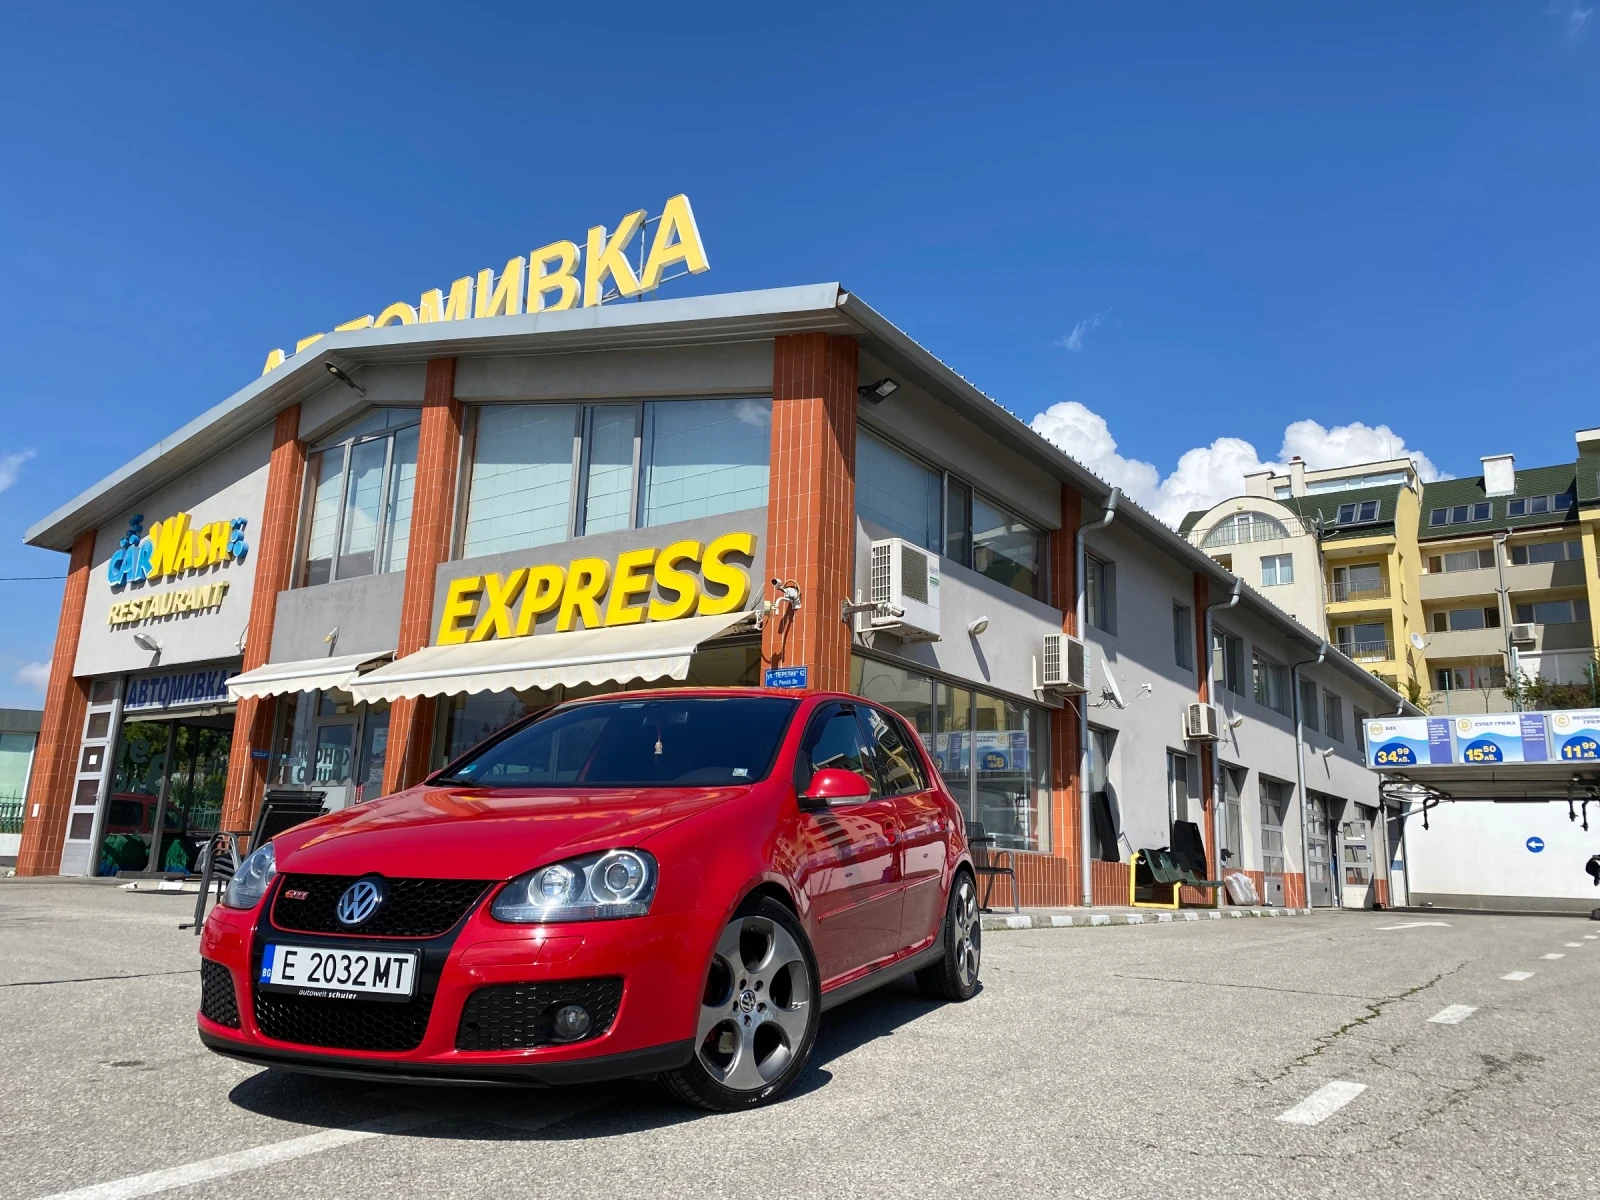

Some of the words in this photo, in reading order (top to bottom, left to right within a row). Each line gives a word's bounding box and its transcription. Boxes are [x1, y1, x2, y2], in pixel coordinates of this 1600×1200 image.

[262, 193, 710, 375] МИВКА
[436, 532, 757, 645] EXPRESS
[107, 581, 229, 624] RESTAURANT
[126, 669, 228, 709] АВТОМИВКА
[1377, 750, 1398, 763] 34
[1466, 748, 1484, 761] 15
[1564, 745, 1581, 758] 11
[262, 968, 272, 978] BG
[281, 950, 298, 981] E
[328, 991, 357, 1000] schuler
